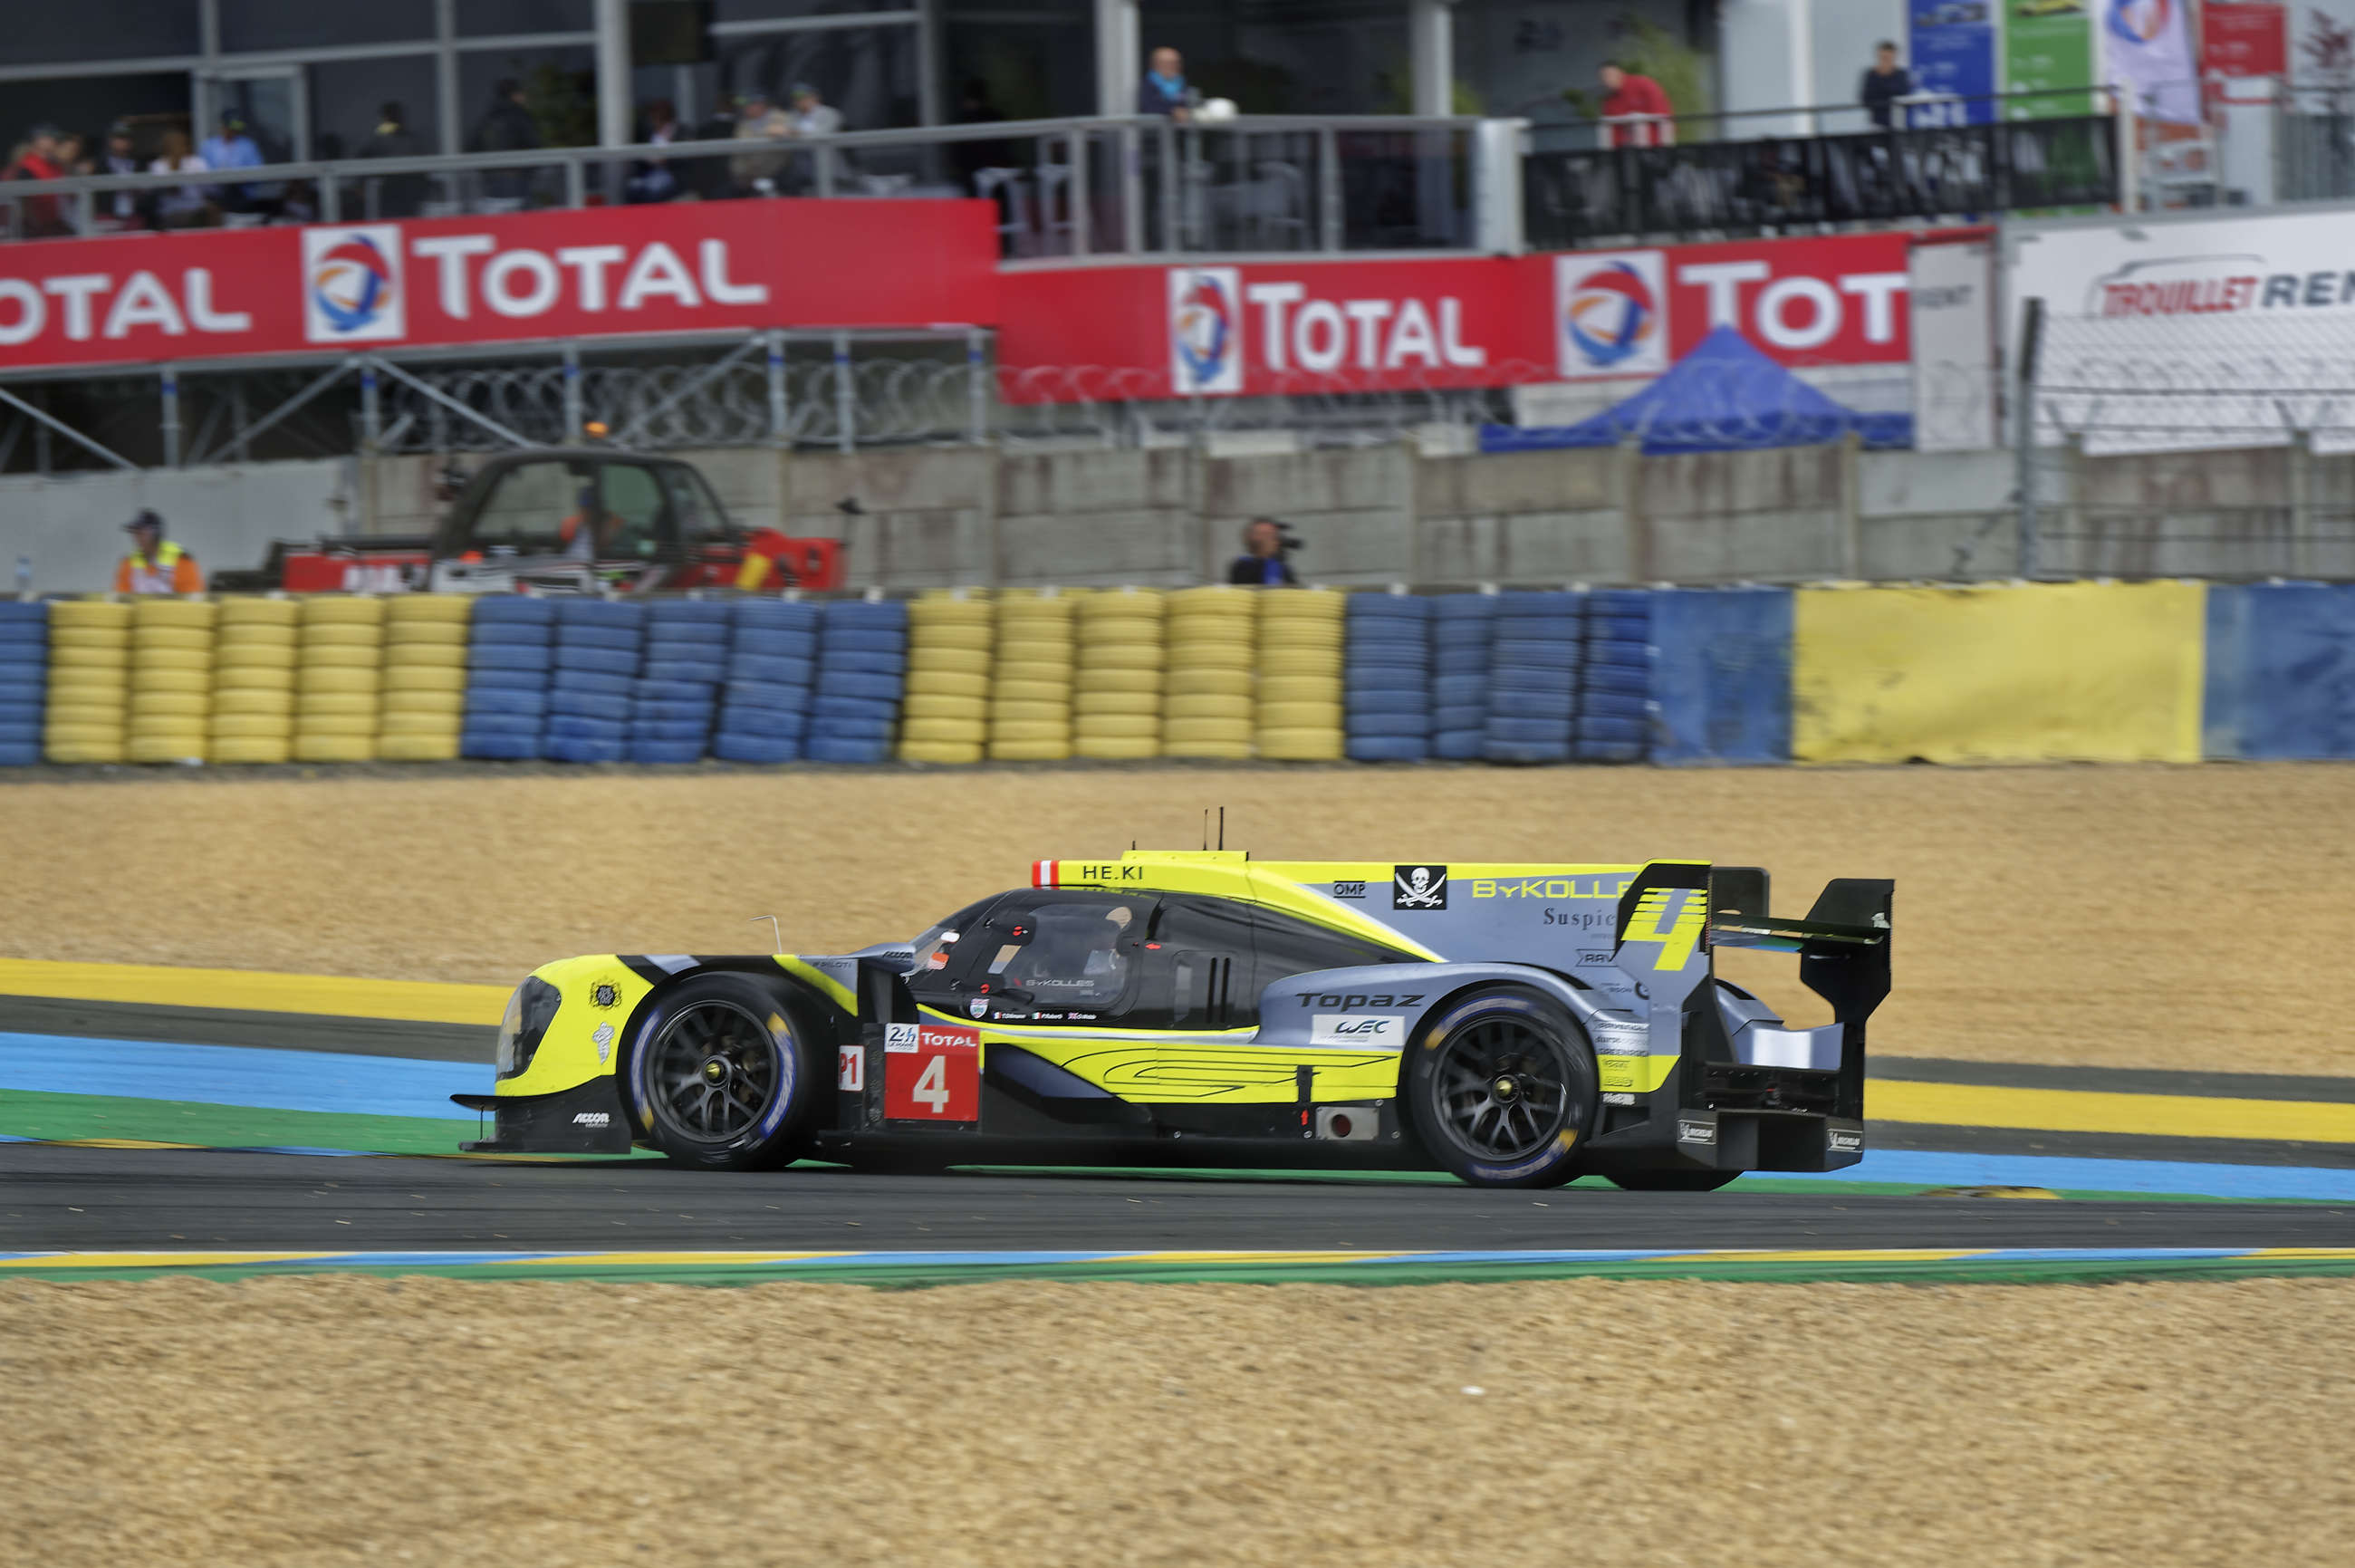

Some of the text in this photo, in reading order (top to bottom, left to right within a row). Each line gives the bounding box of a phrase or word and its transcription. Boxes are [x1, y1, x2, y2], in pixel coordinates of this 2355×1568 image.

[410, 234, 770, 320] TOTAL
[1245, 282, 1488, 371] TOTAL
[1082, 865, 1143, 880] HE.KI
[1333, 883, 1366, 895] OMP
[1621, 887, 1708, 971] 4
[1295, 992, 1426, 1013] Topaz
[1335, 1020, 1390, 1034] WEC
[920, 1032, 977, 1047] TOTAL
[912, 1055, 949, 1113] 4
